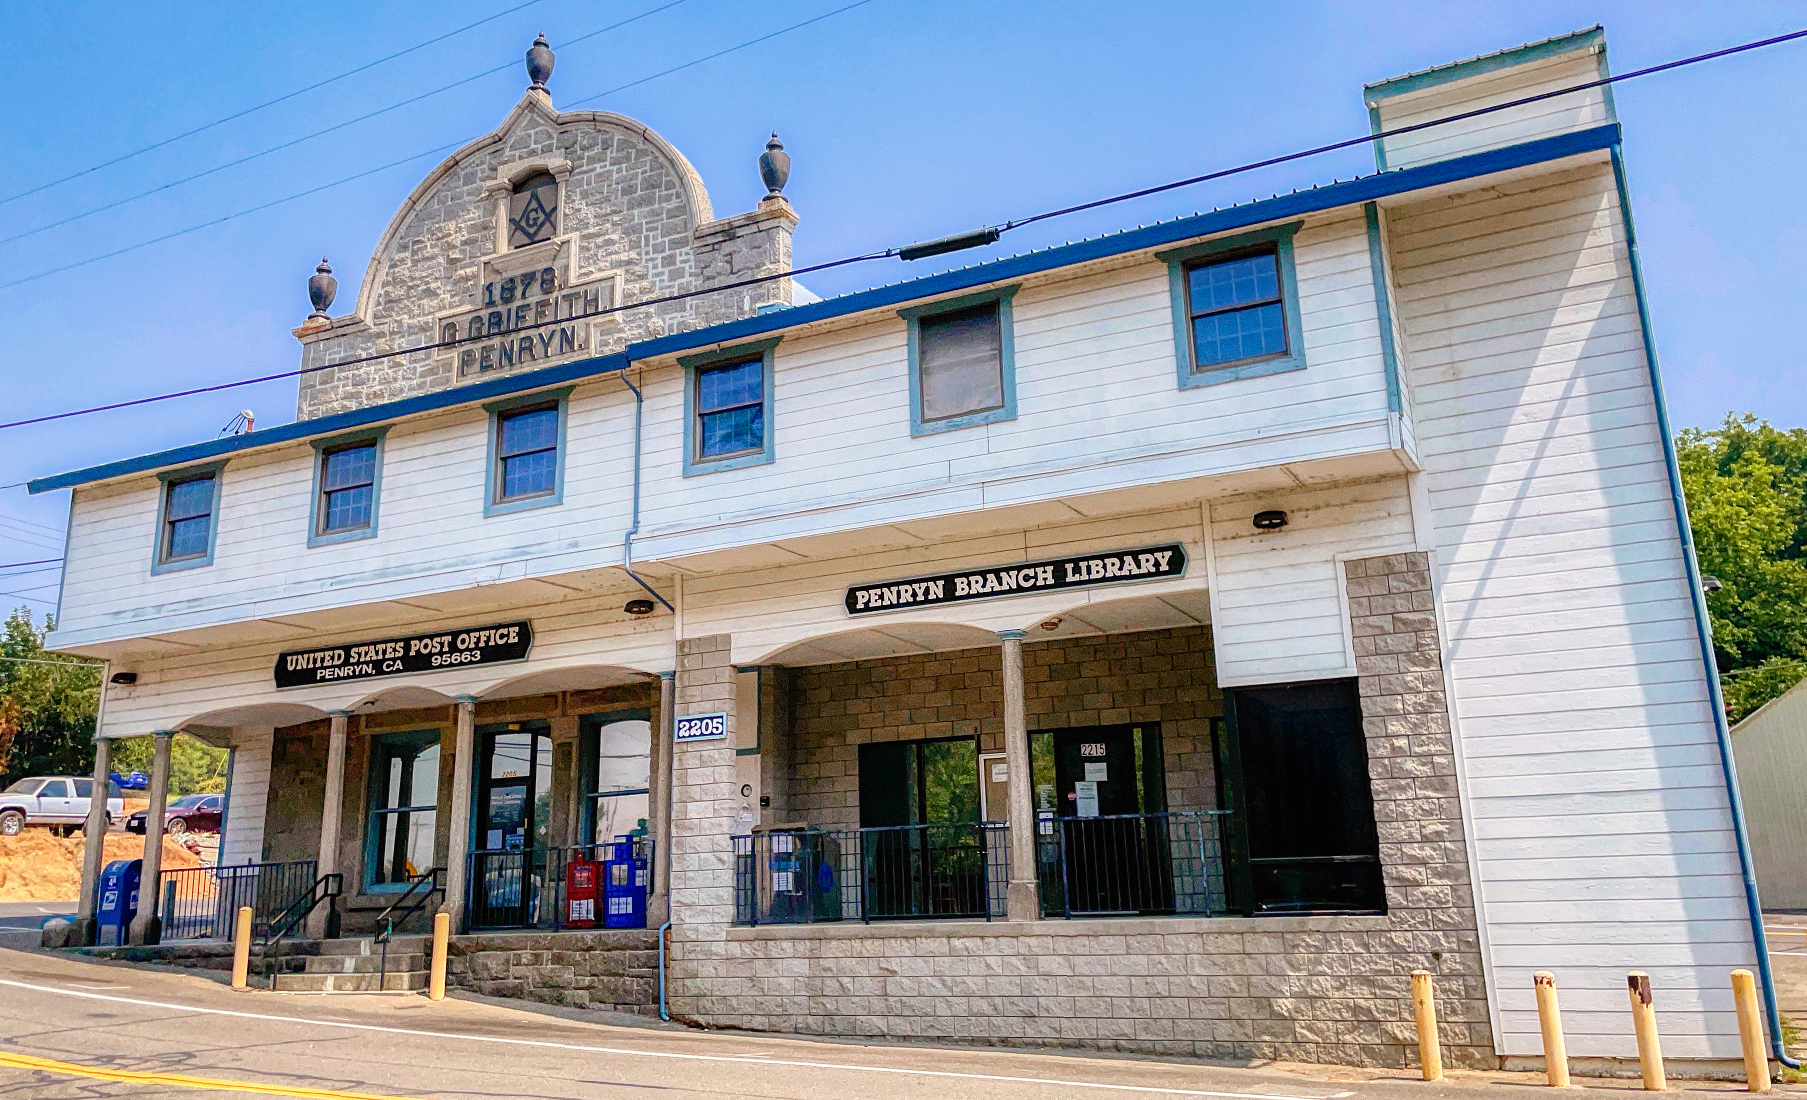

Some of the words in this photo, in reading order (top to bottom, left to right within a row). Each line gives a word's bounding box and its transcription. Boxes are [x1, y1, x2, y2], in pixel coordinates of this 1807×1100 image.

[525, 207, 540, 228] G
[856, 580, 945, 609] PENRYN
[955, 565, 1055, 597] BRANCH
[1064, 551, 1173, 583] LIBRARY
[287, 650, 345, 671] UNITED
[350, 641, 404, 663] STATES
[409, 636, 452, 656] POST
[457, 626, 519, 648] OFFICE
[316, 663, 376, 680] PENRYN,
[382, 659, 403, 672] CA
[431, 650, 481, 666] 95663
[678, 718, 723, 738] 2205
[1081, 744, 1105, 756] 2215
